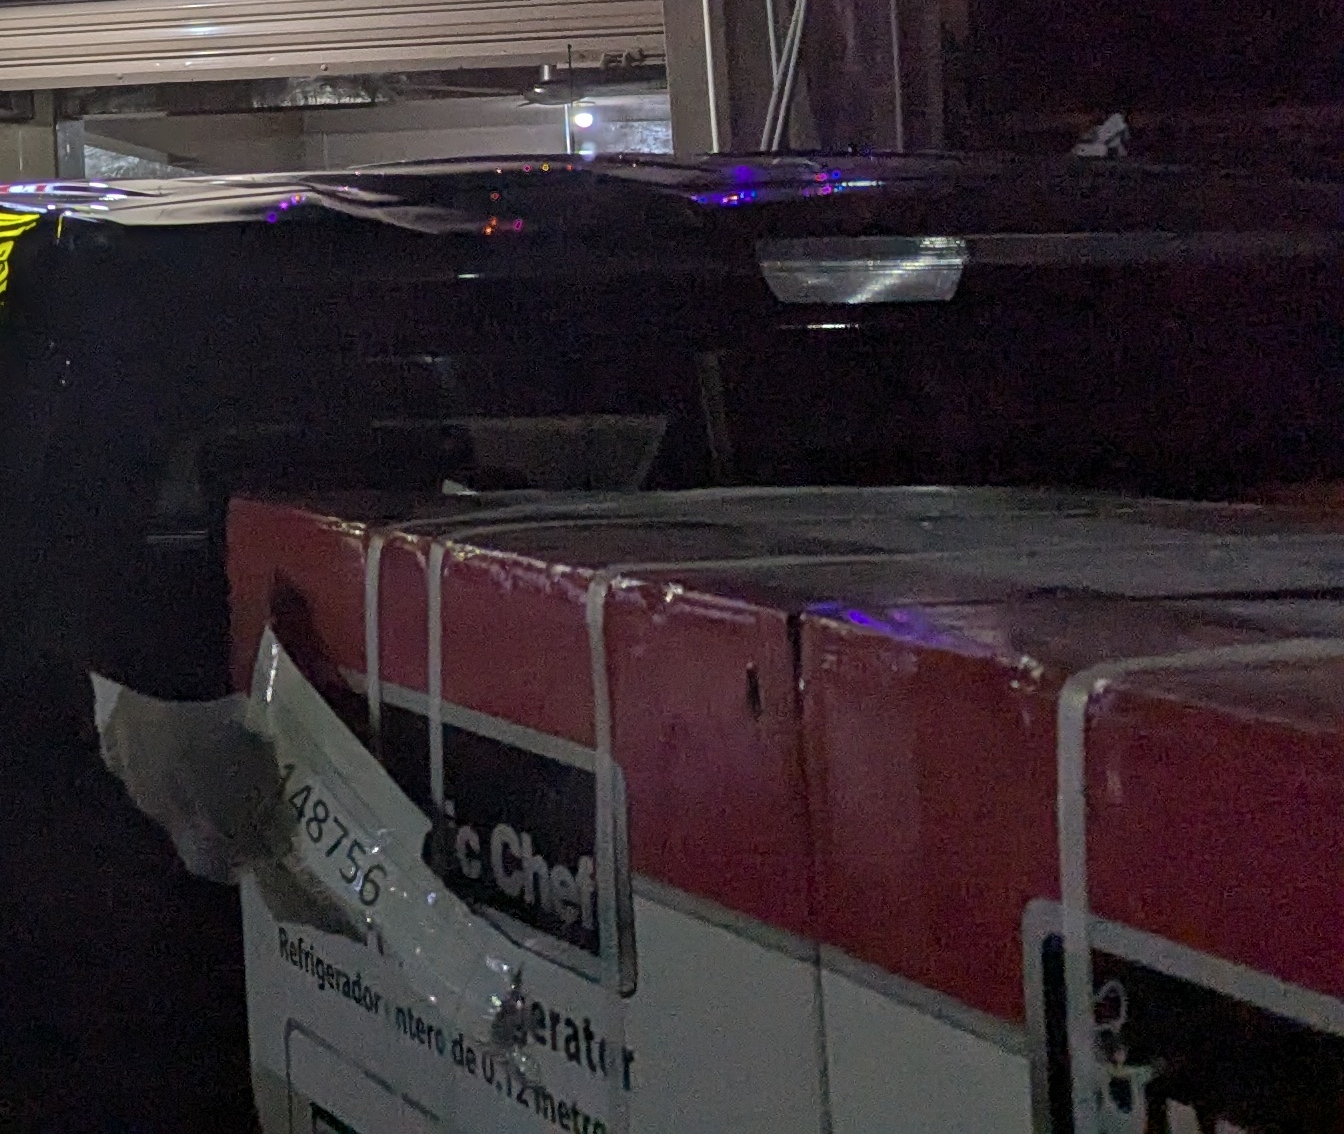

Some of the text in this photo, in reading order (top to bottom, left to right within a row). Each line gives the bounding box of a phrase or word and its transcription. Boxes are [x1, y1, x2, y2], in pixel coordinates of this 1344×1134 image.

[490, 822, 594, 931] Chef
[277, 926, 382, 1015] Refrigerador
[384, 1000, 447, 1056] ntero
[451, 1031, 477, 1075] de
